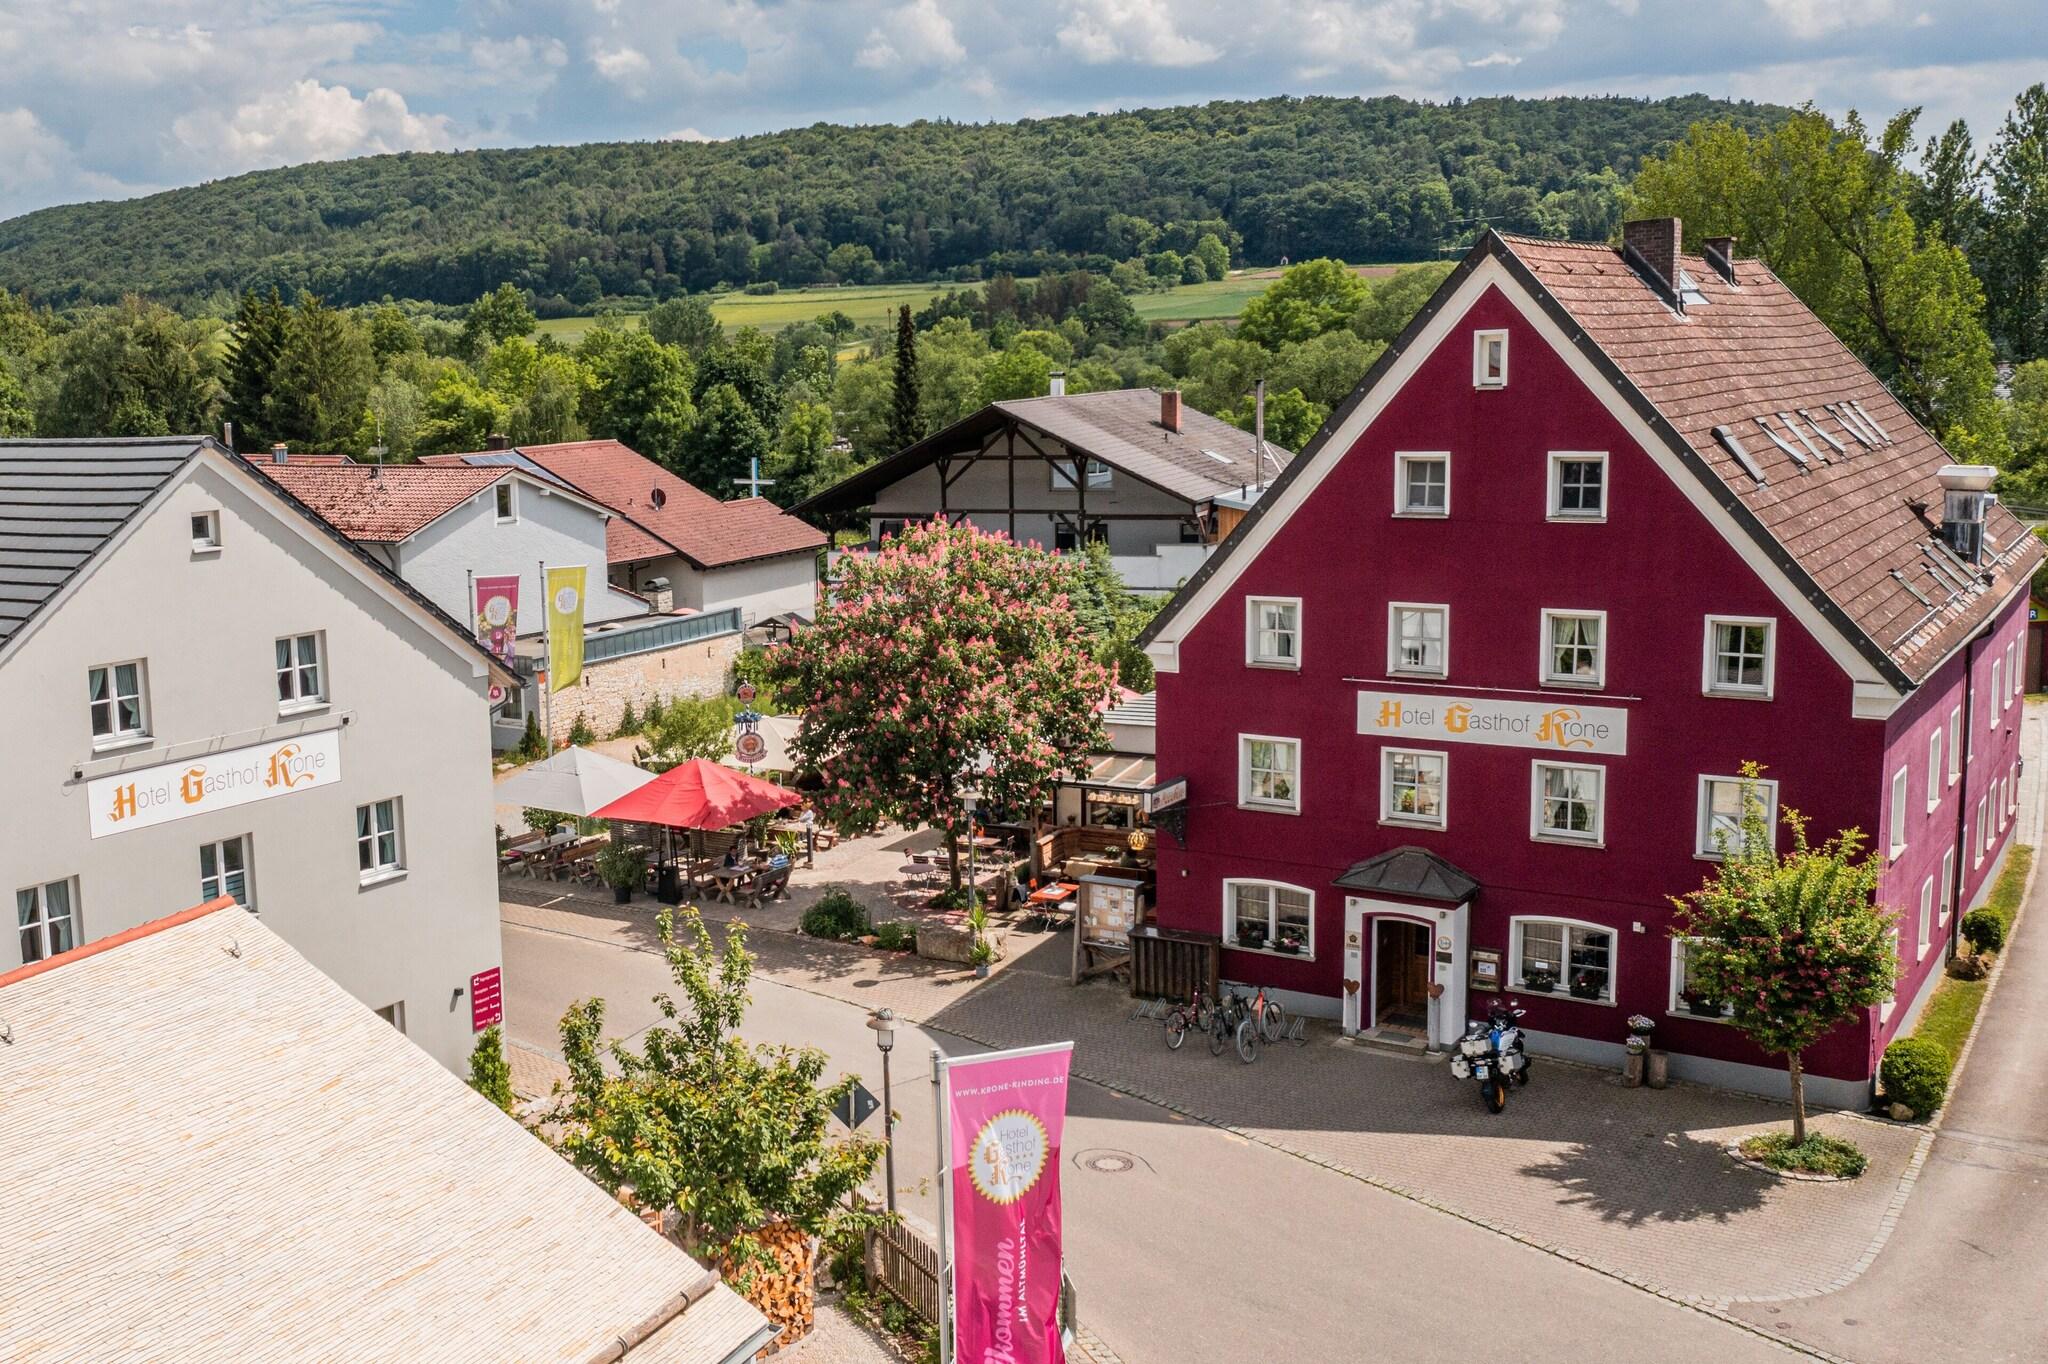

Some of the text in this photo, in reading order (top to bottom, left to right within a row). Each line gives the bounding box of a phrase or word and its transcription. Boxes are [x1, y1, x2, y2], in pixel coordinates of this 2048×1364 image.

[1374, 700, 1609, 748] Hotel Gasthof Krone
[107, 743, 326, 823] Hotel Gasthof Krone
[955, 1075, 1064, 1097] WWW.KRONE-KINDING.DE
[1000, 1126, 1029, 1142] Hotel
[1017, 1217, 1029, 1323] IM ALTMÜHLTAL
